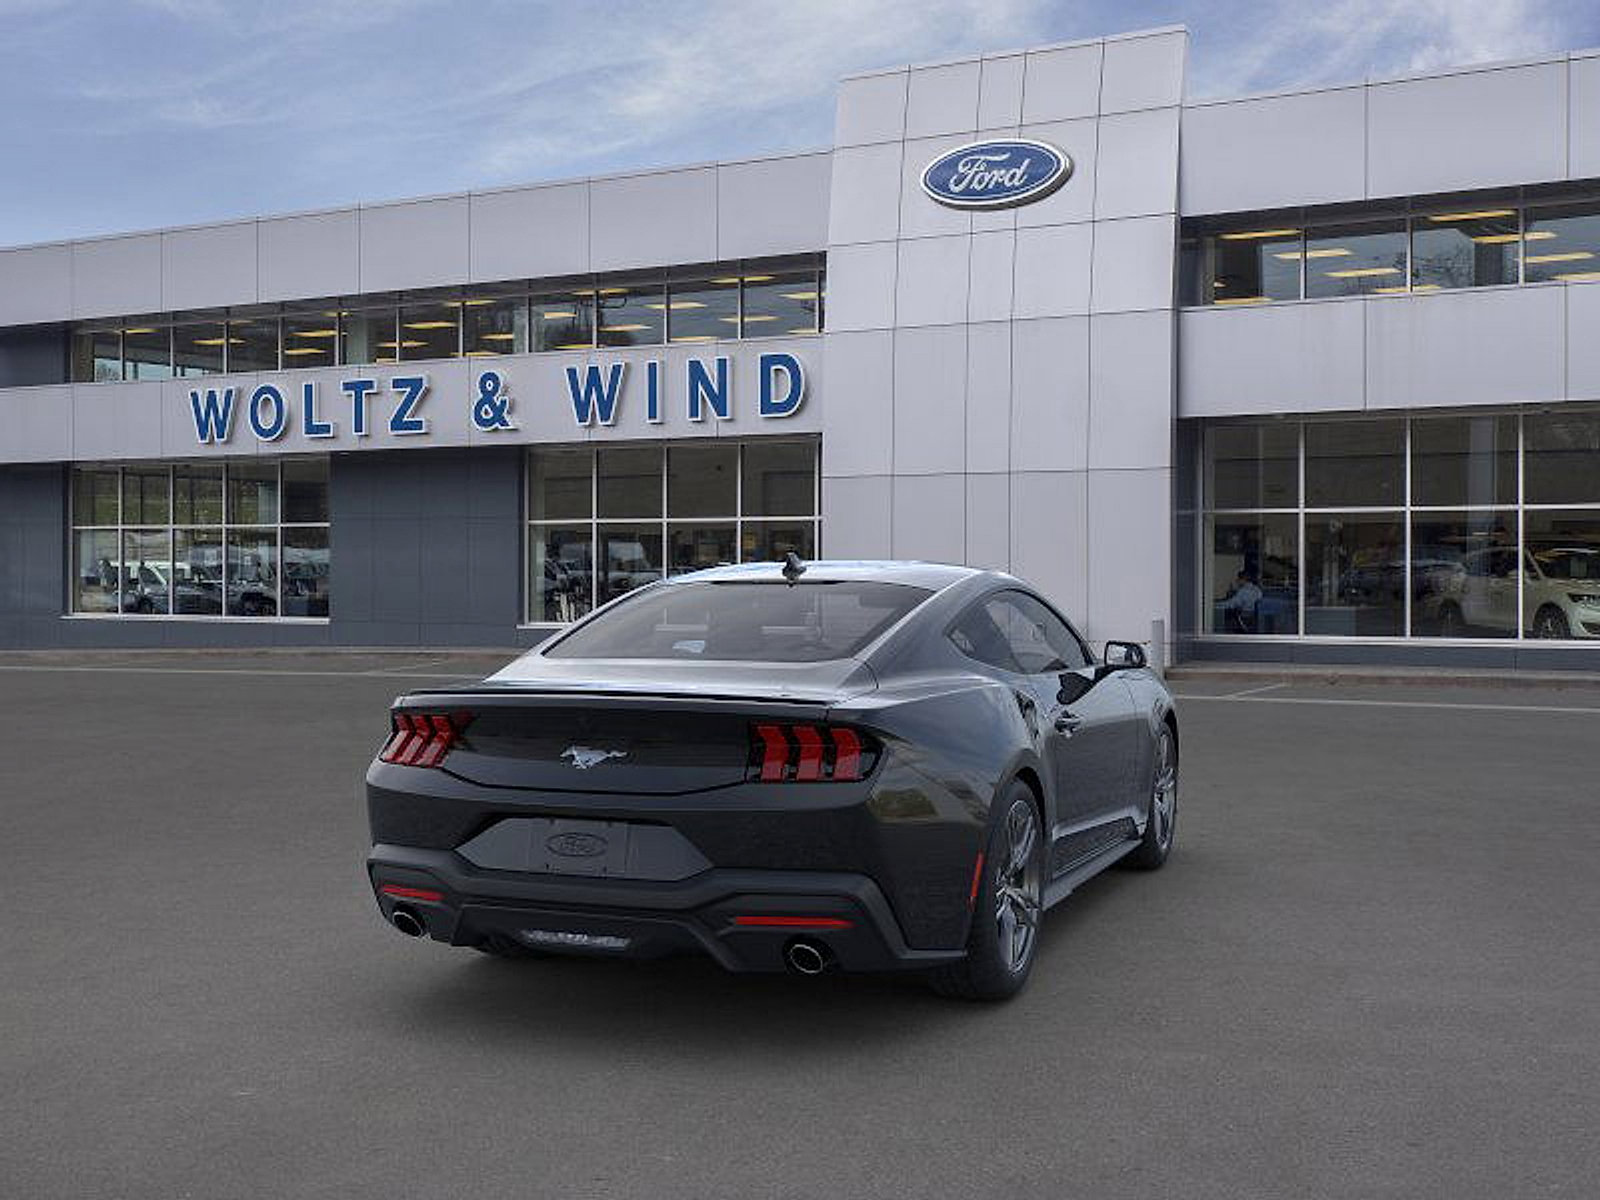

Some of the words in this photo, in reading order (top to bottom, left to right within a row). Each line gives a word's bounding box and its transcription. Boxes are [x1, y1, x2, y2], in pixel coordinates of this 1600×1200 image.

[949, 152, 1031, 193] Ford
[189, 374, 428, 444] WOLTZ
[472, 370, 518, 431] &
[564, 352, 805, 426] WIND
